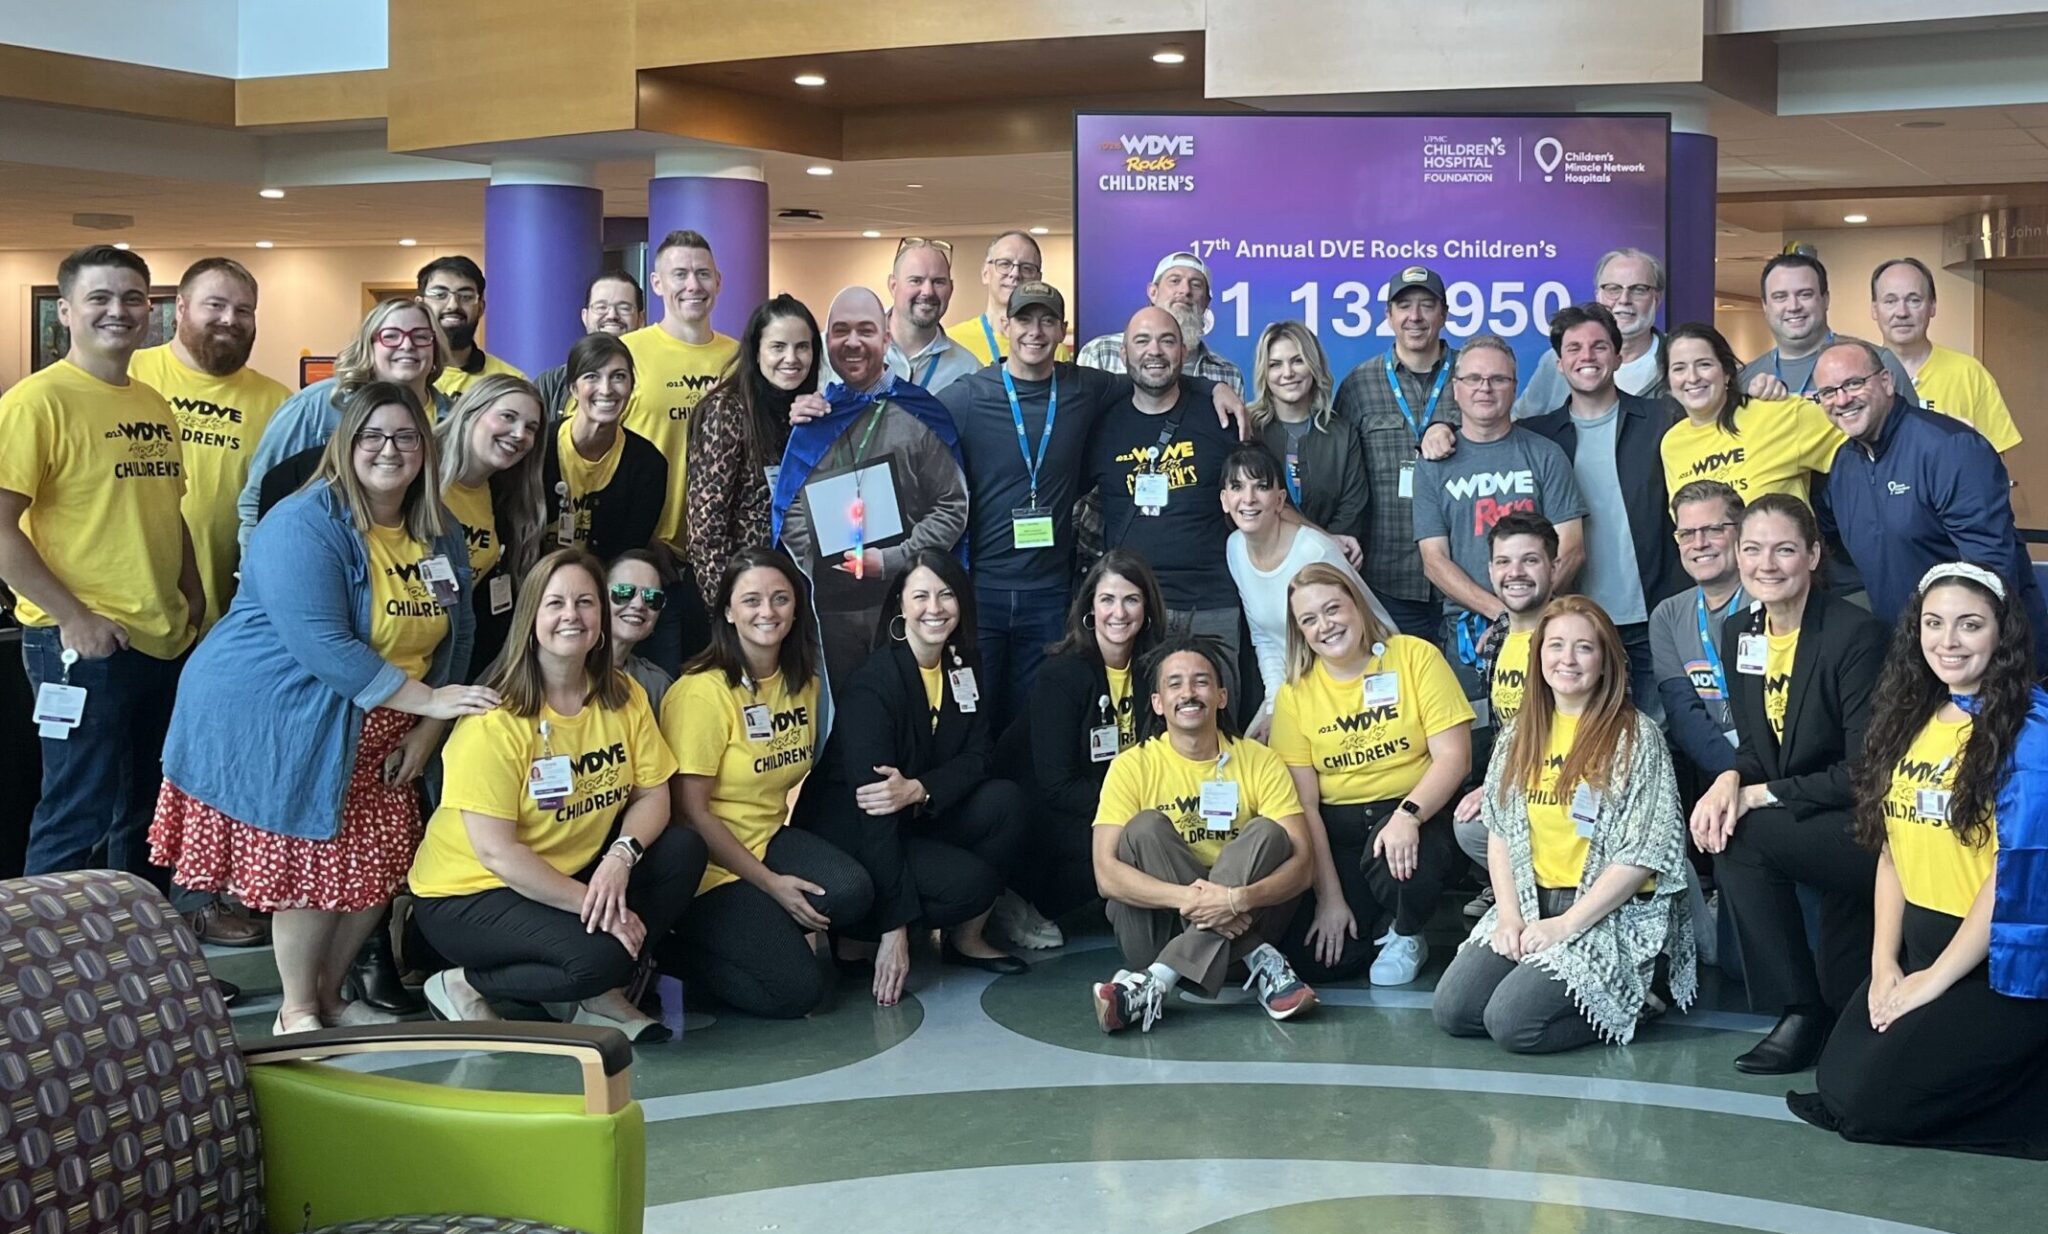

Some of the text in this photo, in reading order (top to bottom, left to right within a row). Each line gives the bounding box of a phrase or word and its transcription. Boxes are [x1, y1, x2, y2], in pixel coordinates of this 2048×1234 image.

[1120, 134, 1194, 155] WDVE
[1424, 144, 1506, 156] CHILDREN'S
[1126, 156, 1177, 172] Rocks
[1424, 157, 1493, 169] HOSPITAL
[1565, 152, 1614, 162] Children's
[1565, 163, 1645, 173] Miracle Network
[1099, 175, 1195, 192] CHILDREN'S
[1424, 173, 1493, 183] FOUNDATION
[1565, 173, 1612, 184] Hospitals
[2010, 225, 2042, 239] John
[1190, 239, 1557, 259] 17th Annual DVE Rocks Children's
[172, 396, 242, 424] WDVE
[118, 421, 173, 442] WDVE
[181, 428, 241, 450] DREN'S
[1131, 441, 1195, 463] WVE
[1692, 447, 1745, 476] WDVE
[115, 461, 181, 479] CHILDREN'S
[1444, 469, 1534, 501] WDVE
[1497, 669, 1525, 688] WD
[1336, 703, 1399, 733] WDVE
[1323, 736, 1410, 769] CHILDREN'S
[574, 767, 621, 795] Rocks
[555, 783, 631, 822] CHILDREN'S
[1181, 827, 1240, 845] DREN'S
